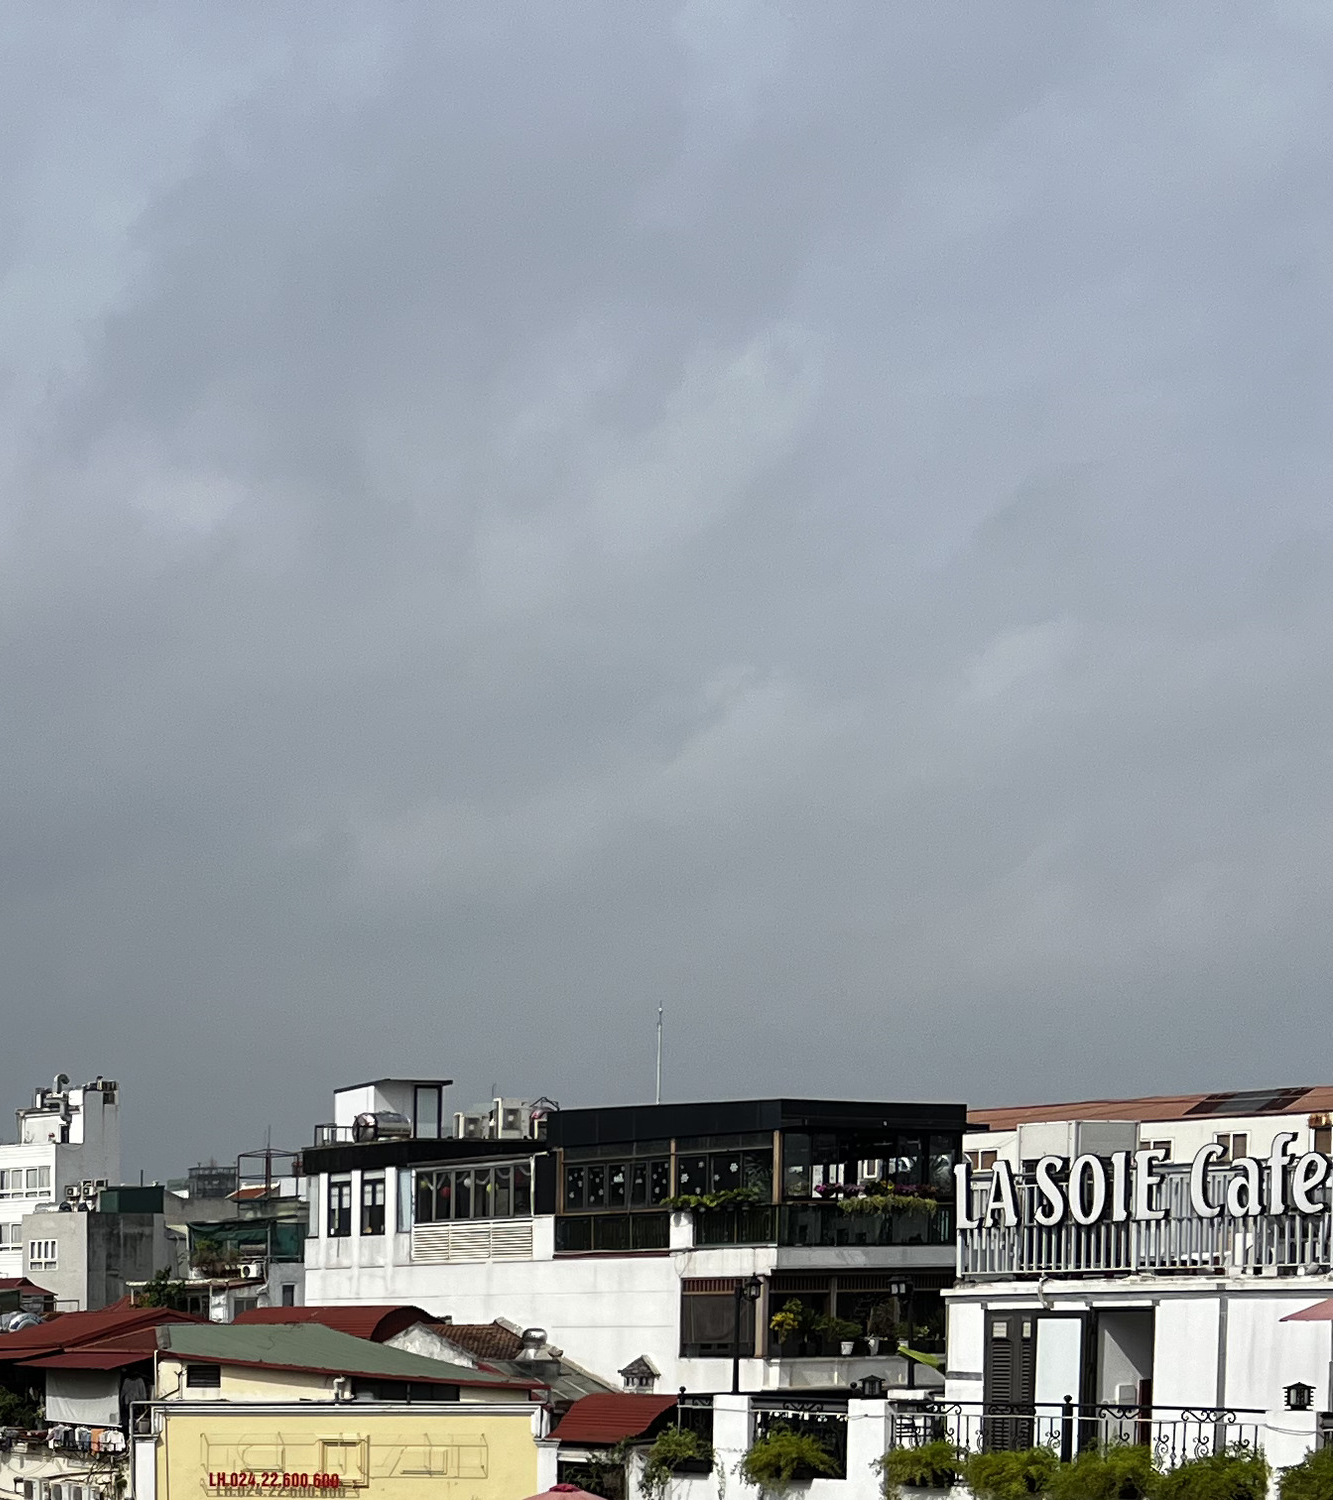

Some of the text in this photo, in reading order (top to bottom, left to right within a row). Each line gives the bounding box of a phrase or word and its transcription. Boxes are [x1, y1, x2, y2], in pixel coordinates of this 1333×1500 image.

[953, 1131, 1330, 1229] LA SOIE Cafe
